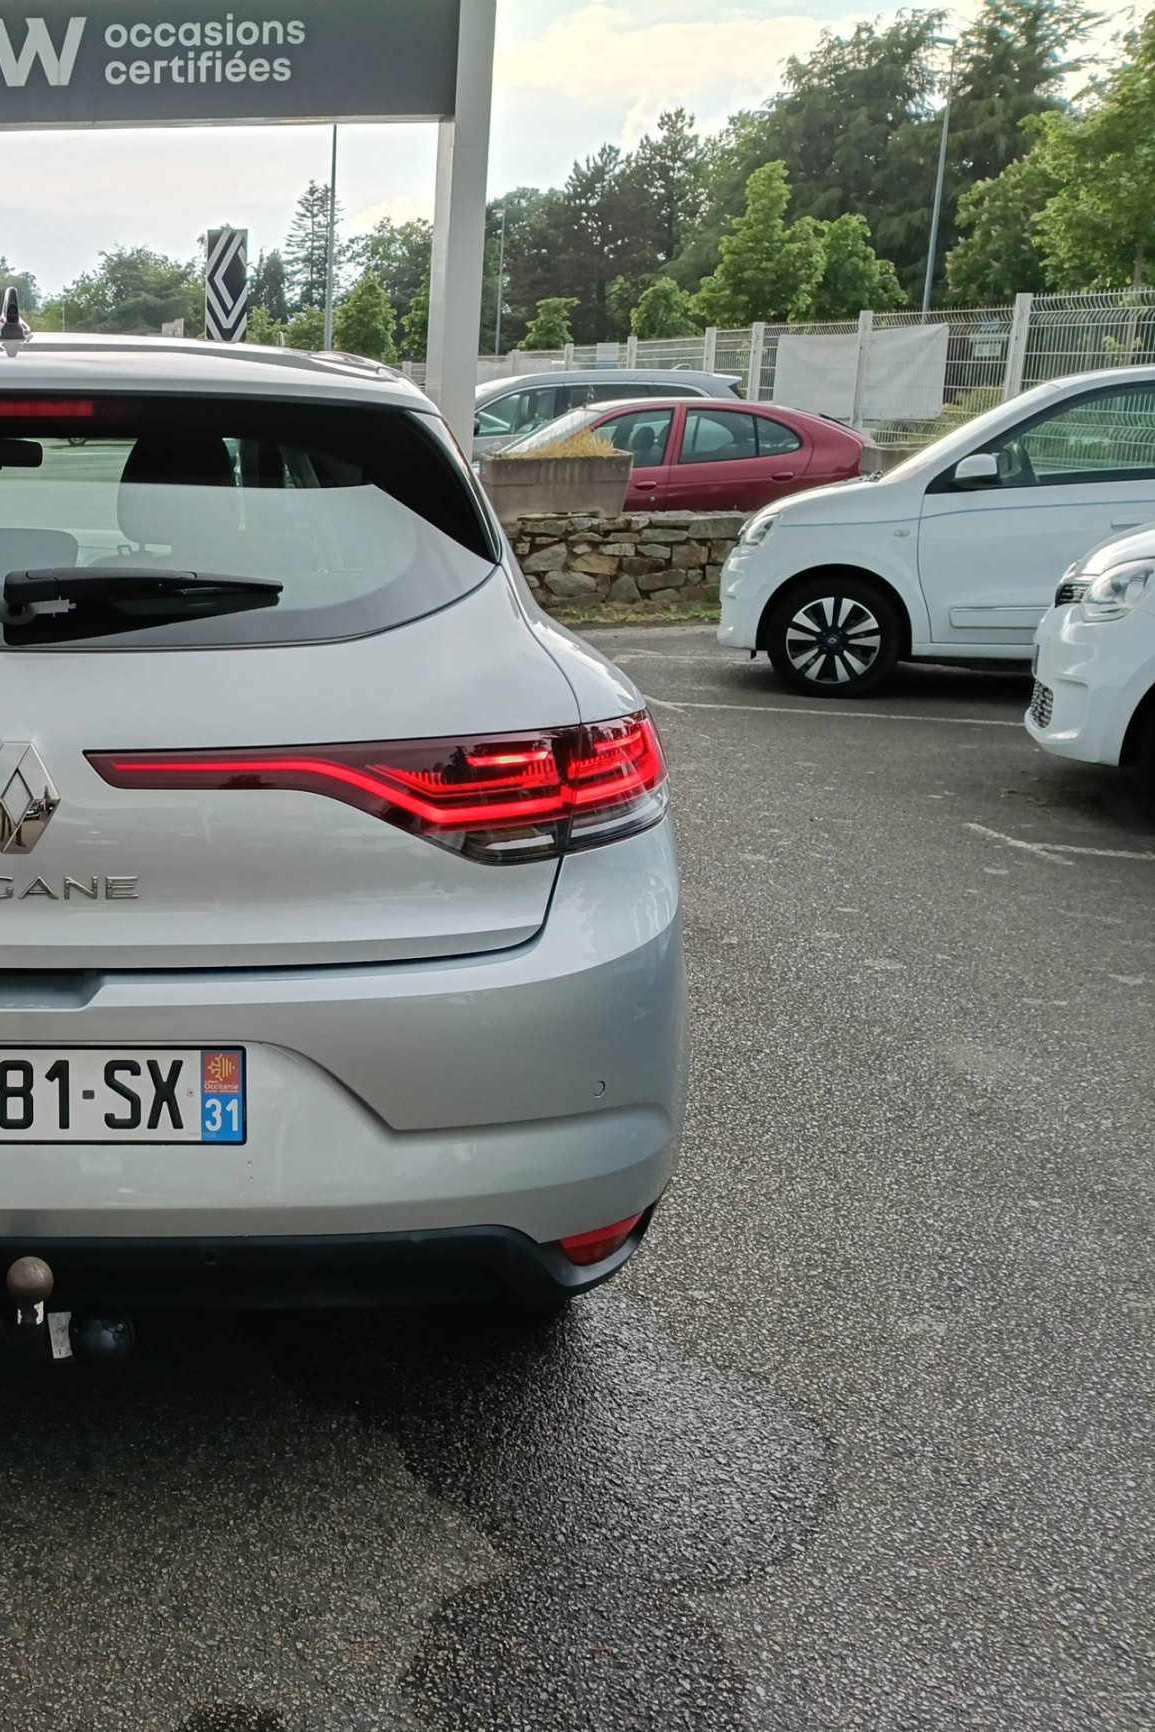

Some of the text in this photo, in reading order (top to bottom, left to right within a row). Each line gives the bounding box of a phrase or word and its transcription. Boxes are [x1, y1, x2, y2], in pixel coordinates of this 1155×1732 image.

[104, 13, 306, 48] occasions
[104, 50, 292, 85] certifiées
[204, 1082, 239, 1090] Occitanie
[205, 1098, 239, 1132] 31
